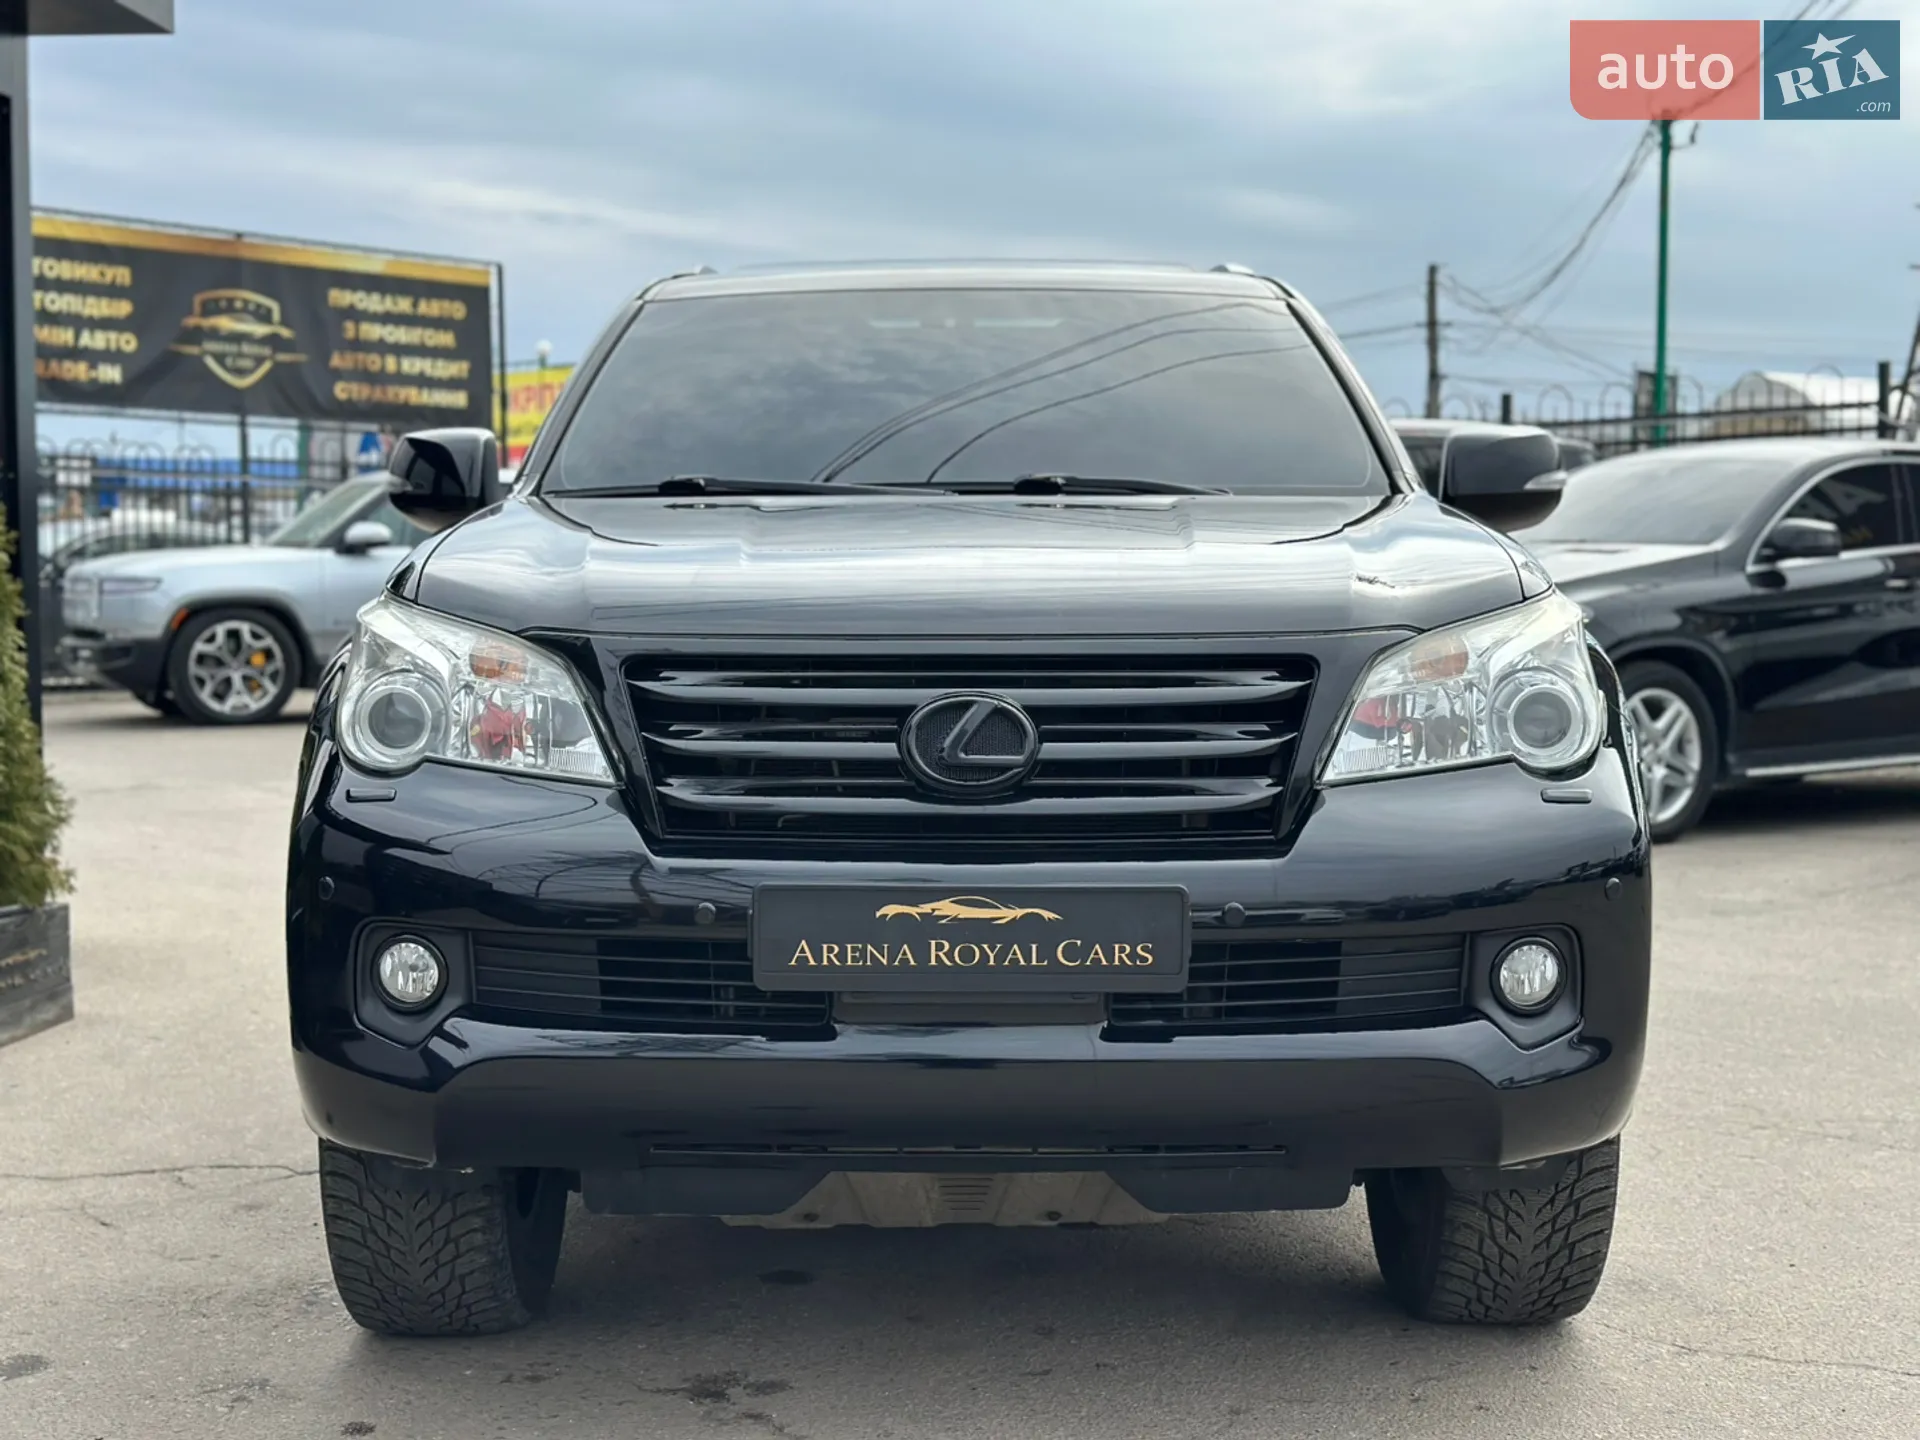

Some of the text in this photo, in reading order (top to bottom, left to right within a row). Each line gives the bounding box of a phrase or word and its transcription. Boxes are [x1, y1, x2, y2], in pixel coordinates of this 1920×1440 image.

[327, 287, 468, 321] ПРОДАЖ АВТО
[78, 327, 139, 354] АВТО
[328, 349, 382, 375] АВТО
[399, 354, 471, 381] КРЕДИТ
[332, 379, 469, 411] СТРАХУВАННЯ
[788, 938, 1154, 968] ARENA ROYAL CARS
